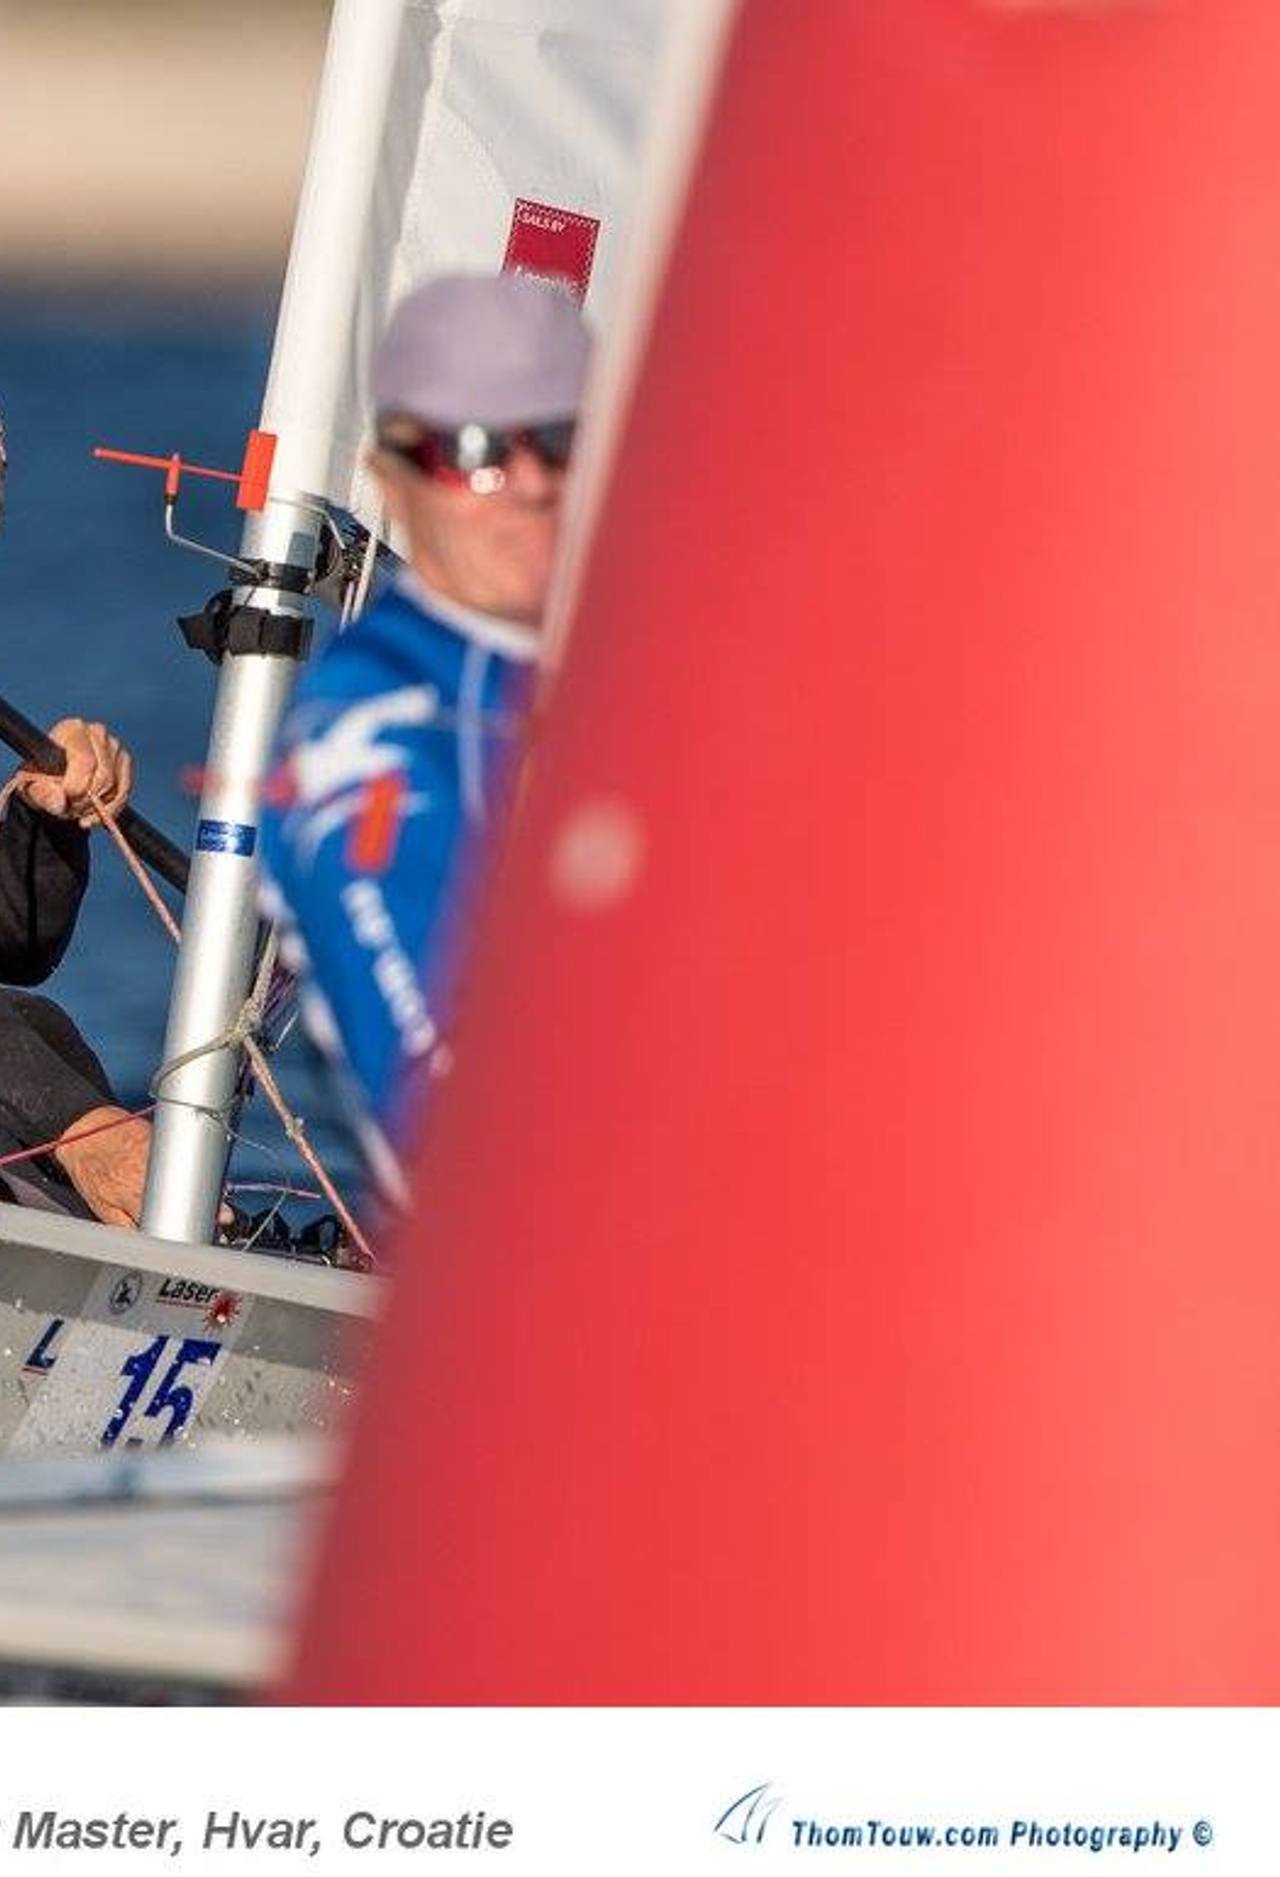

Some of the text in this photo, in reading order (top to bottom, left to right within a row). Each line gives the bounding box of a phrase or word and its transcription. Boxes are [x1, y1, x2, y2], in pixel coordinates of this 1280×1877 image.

[521, 212, 566, 233] SAILS BY
[157, 1278, 220, 1300] Laser
[96, 1334, 224, 1449] 15
